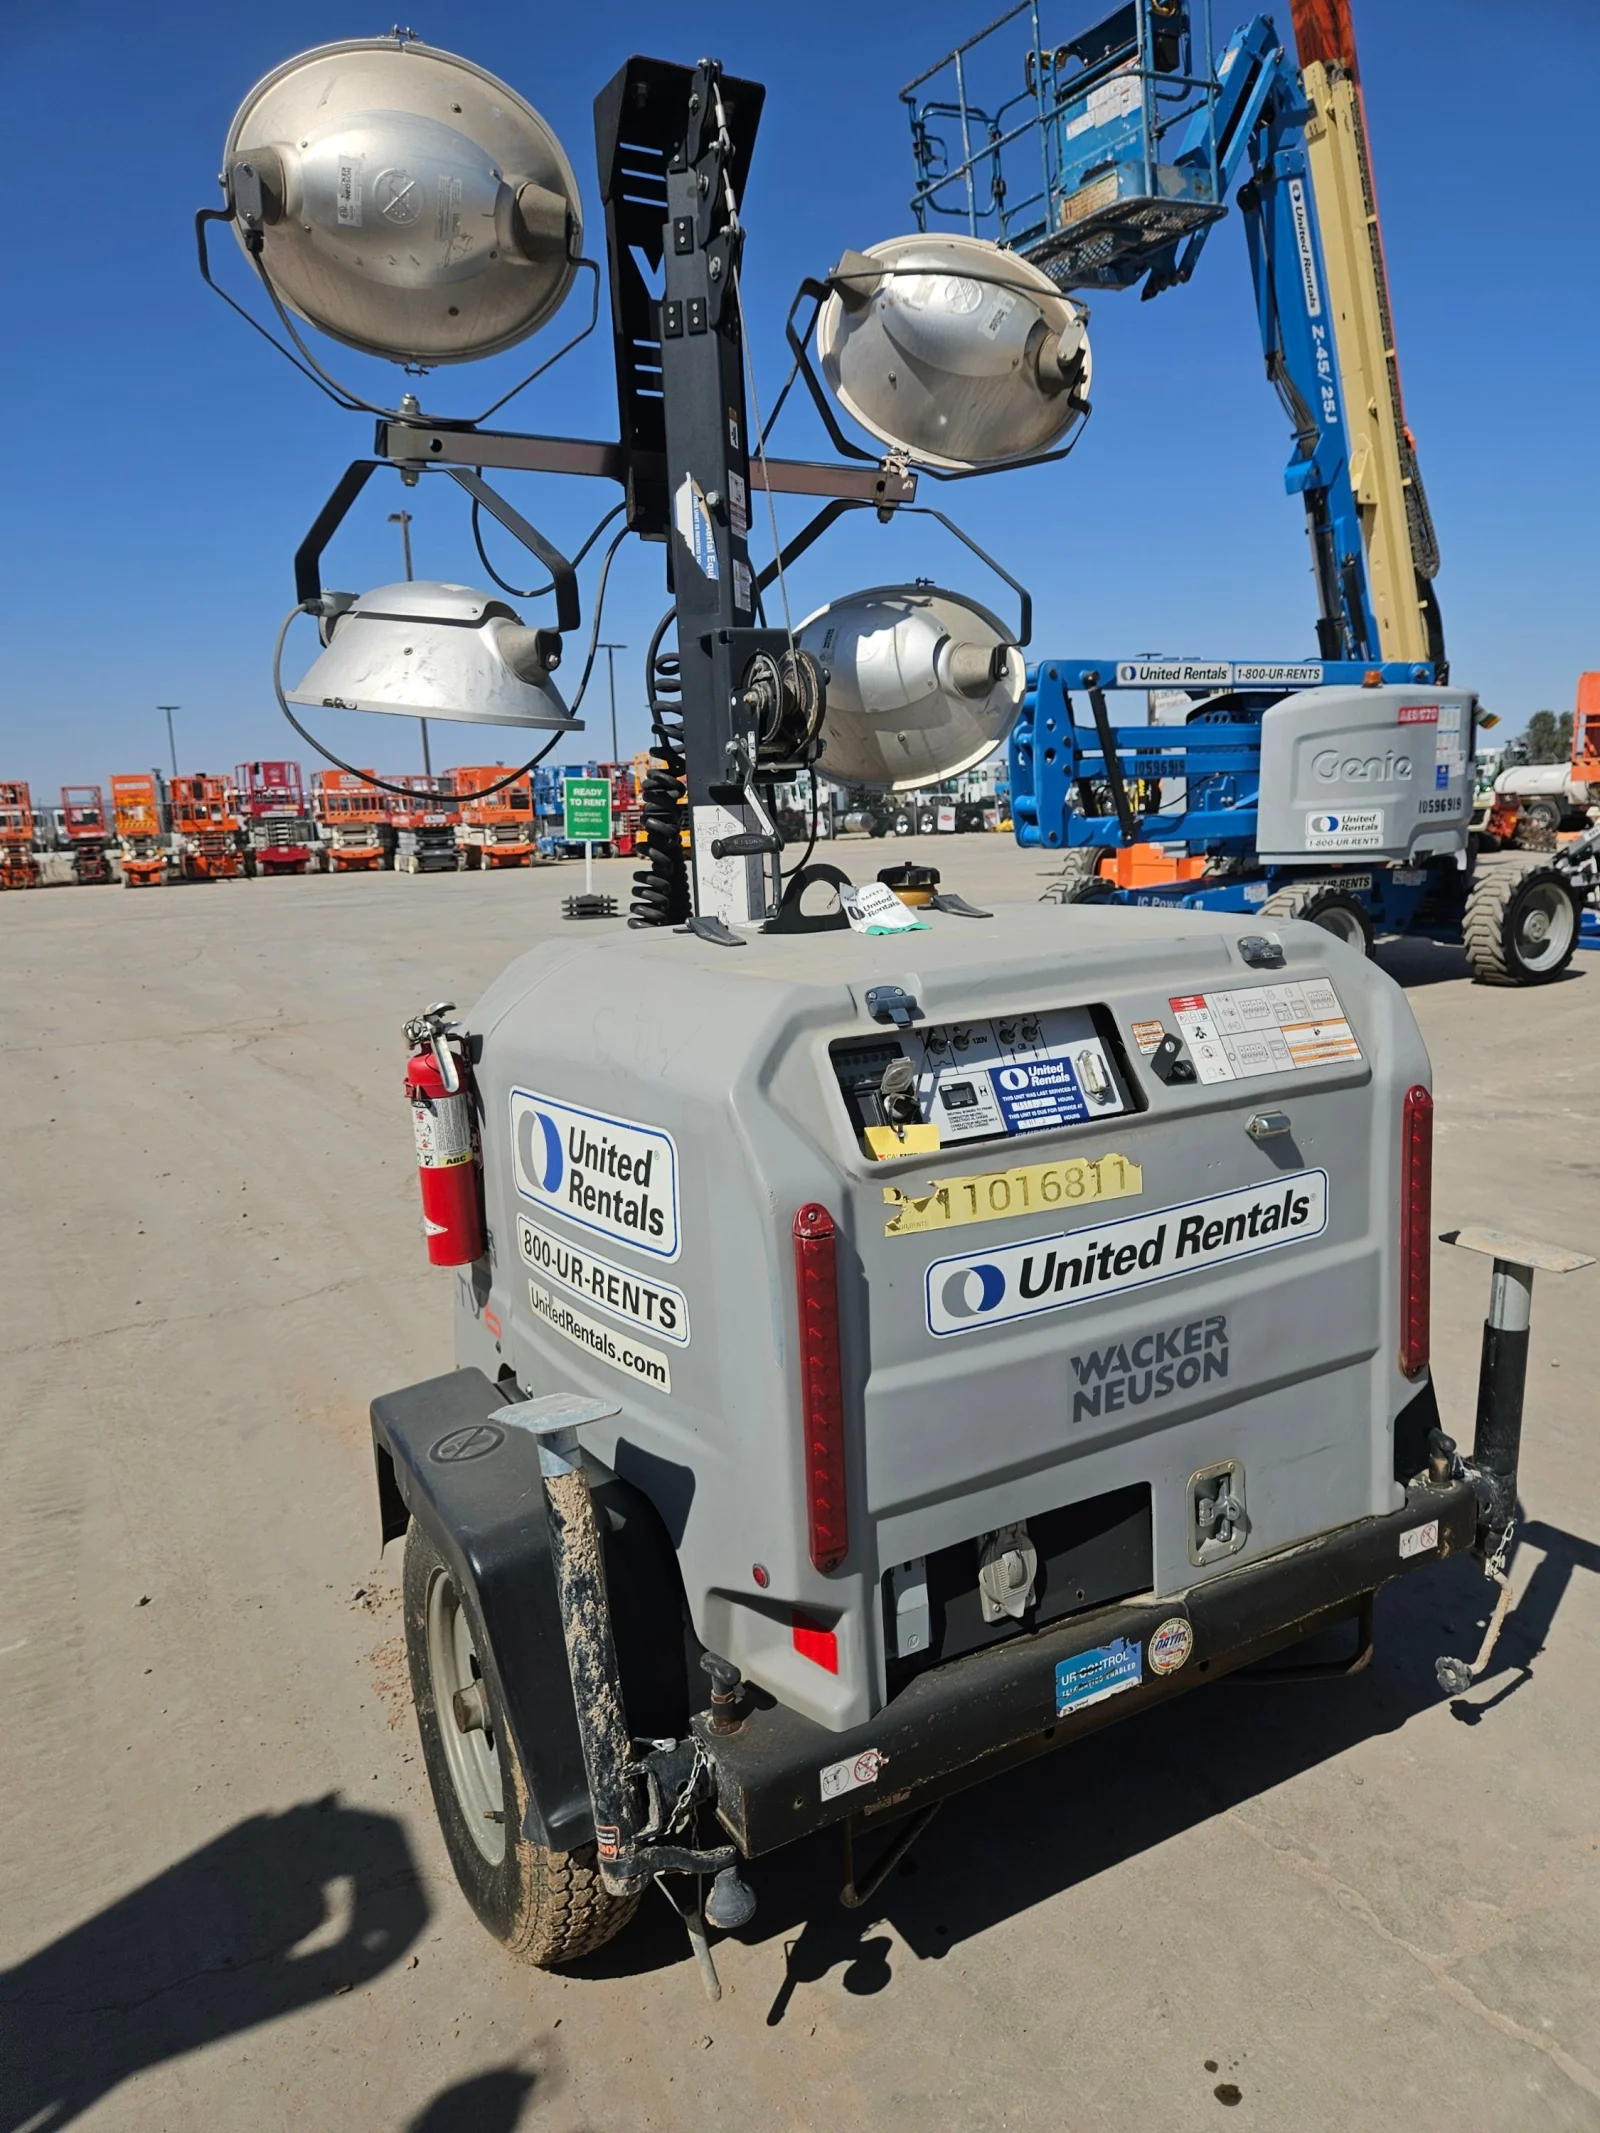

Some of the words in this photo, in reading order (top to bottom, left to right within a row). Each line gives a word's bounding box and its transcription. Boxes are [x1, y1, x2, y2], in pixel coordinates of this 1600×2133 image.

[1295, 206, 1309, 253] United
[1304, 255, 1317, 309] Rentals
[1140, 666, 1180, 681] United
[1184, 665, 1228, 680] Rentals
[1237, 668, 1320, 680] 1-800-UR-RENTS
[1311, 749, 1412, 784] Genie
[573, 788, 603, 796] READY
[570, 798, 582, 807] TO
[584, 799, 607, 807] RENT
[1418, 797, 1462, 814] 10596919
[1342, 814, 1376, 824] United
[1341, 823, 1378, 832] Rentals
[1309, 836, 1380, 847] 1-800-UR-RENTS
[861, 889, 884, 901] SAFETY
[863, 895, 893, 912] United
[867, 900, 901, 918] Rentals
[972, 1036, 988, 1044] 120V
[1028, 1062, 1064, 1077] United
[1031, 1073, 1071, 1087] Rentals
[1049, 1086, 1071, 1095] SERVICED
[1057, 1095, 1074, 1103] HOURS
[1058, 1104, 1077, 1112] SERVICE
[446, 1155, 467, 1165] ABC
[568, 1126, 654, 1188] United
[568, 1168, 664, 1237] Rentals
[1019, 1223, 1166, 1299] United
[1175, 1189, 1311, 1259] Rentals
[524, 1229, 677, 1329] 800-UR-RENTS
[531, 1284, 667, 1384] UnitedRentals.com
[1070, 1314, 1229, 1386] WACKER
[1072, 1347, 1229, 1424] NEUSON
[1061, 1671, 1077, 1686] UR
[1079, 1651, 1129, 1677] CONTROL
